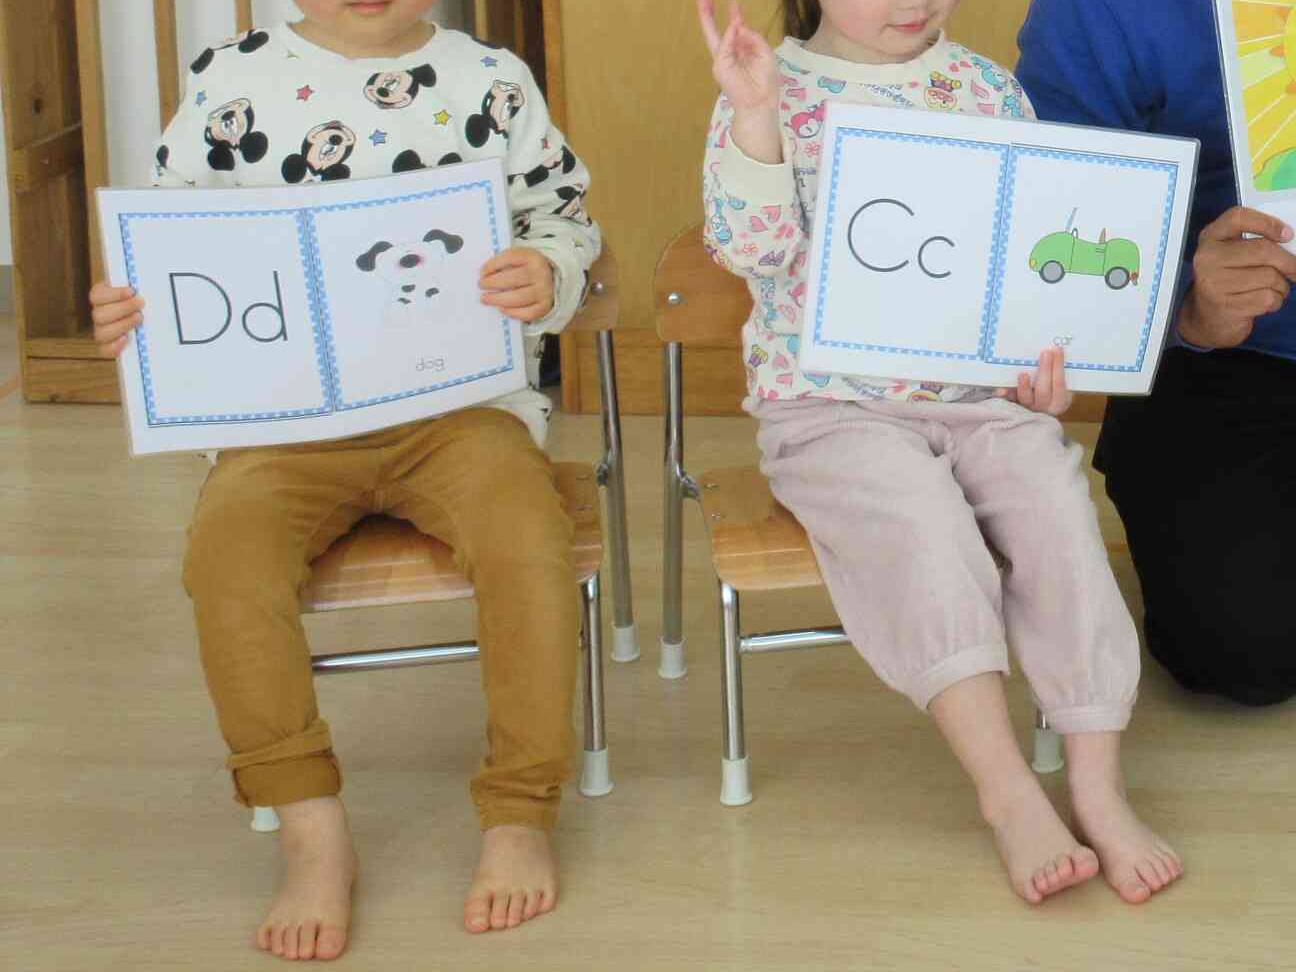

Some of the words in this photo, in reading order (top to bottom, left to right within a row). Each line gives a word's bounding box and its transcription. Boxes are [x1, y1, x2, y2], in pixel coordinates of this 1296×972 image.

[847, 198, 956, 279] Cc
[168, 269, 289, 345] Dd
[414, 354, 446, 373] dog
